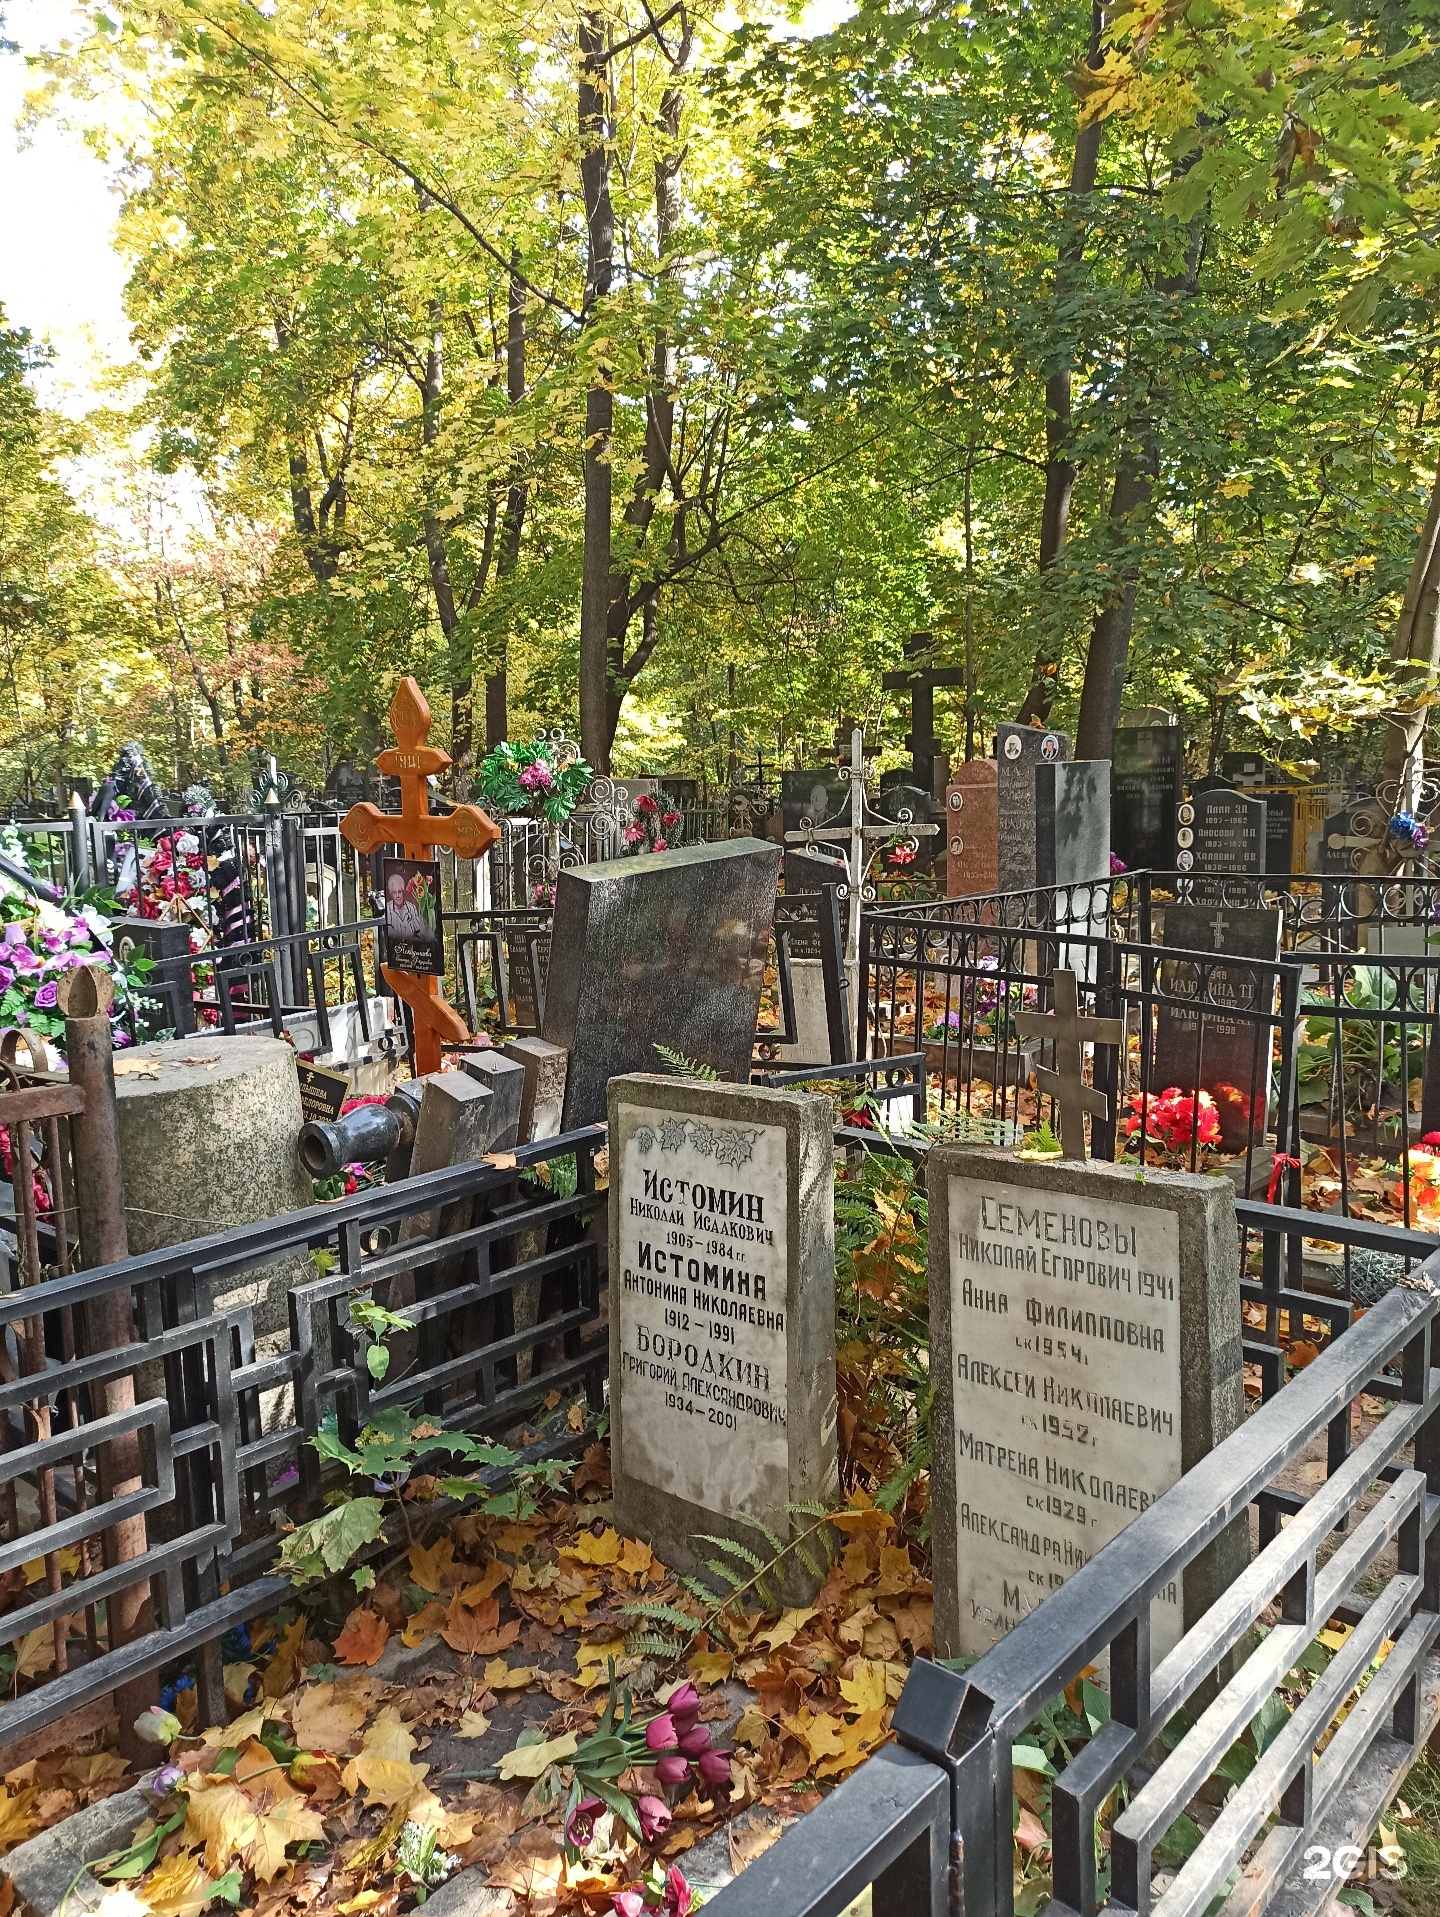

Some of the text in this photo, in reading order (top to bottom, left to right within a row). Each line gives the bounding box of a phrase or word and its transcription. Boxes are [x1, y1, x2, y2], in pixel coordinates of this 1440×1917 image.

[1170, 978, 1235, 998] ИЛЮИНА
[630, 1197, 774, 1247] НИКОЛАЙ ИСААКОВИЧ
[643, 1169, 765, 1224] ИСТОМИН
[980, 1196, 1137, 1258] СЕМЕНОВЫ
[638, 1241, 767, 1301] ИСТОМИНА
[958, 1232, 1037, 1273] НИКОЛАЙ
[1138, 1270, 1174, 1301] 1941
[624, 1269, 784, 1332] АНТОНИНА НИКОЛАЕВНА
[962, 1278, 1165, 1353] АННА ФИЛИППОВНА
[622, 1352, 787, 1426] ГРИГОРИЙ АЛЕКСАНДРОВИЧ
[636, 1324, 770, 1393] БОРОДКИН
[958, 1429, 1160, 1512] МАТРЕНА НИКОЛАЕВ
